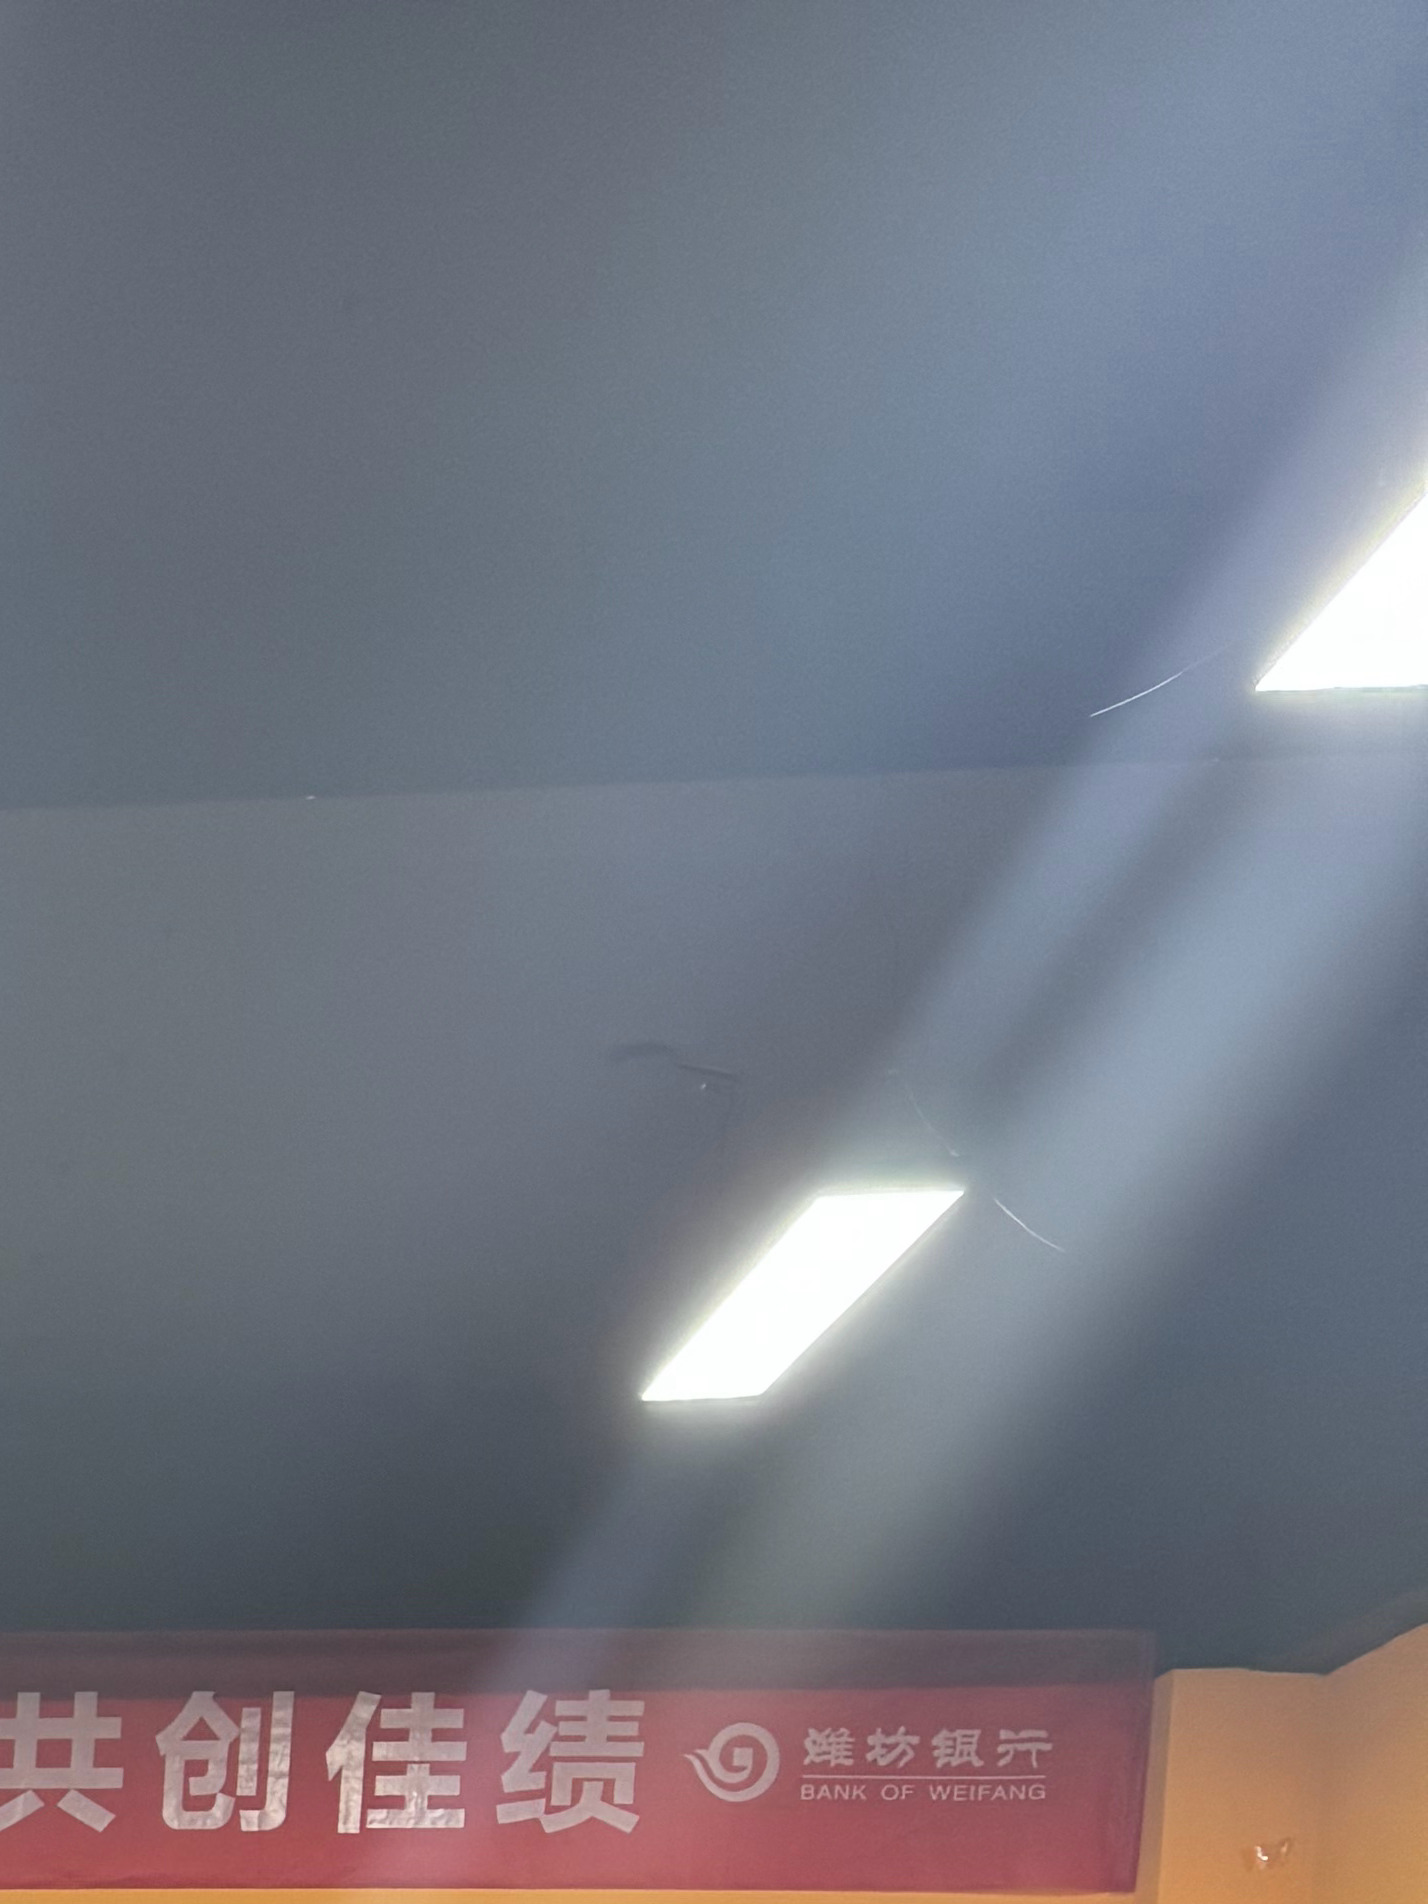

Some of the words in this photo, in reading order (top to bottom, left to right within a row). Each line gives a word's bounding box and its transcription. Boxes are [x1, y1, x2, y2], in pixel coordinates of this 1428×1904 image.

[802, 1726, 1052, 1768] 潍坊银行
[800, 1784, 867, 1801] BANK
[881, 1784, 916, 1801] OF
[929, 1784, 1047, 1801] WEIFANG
